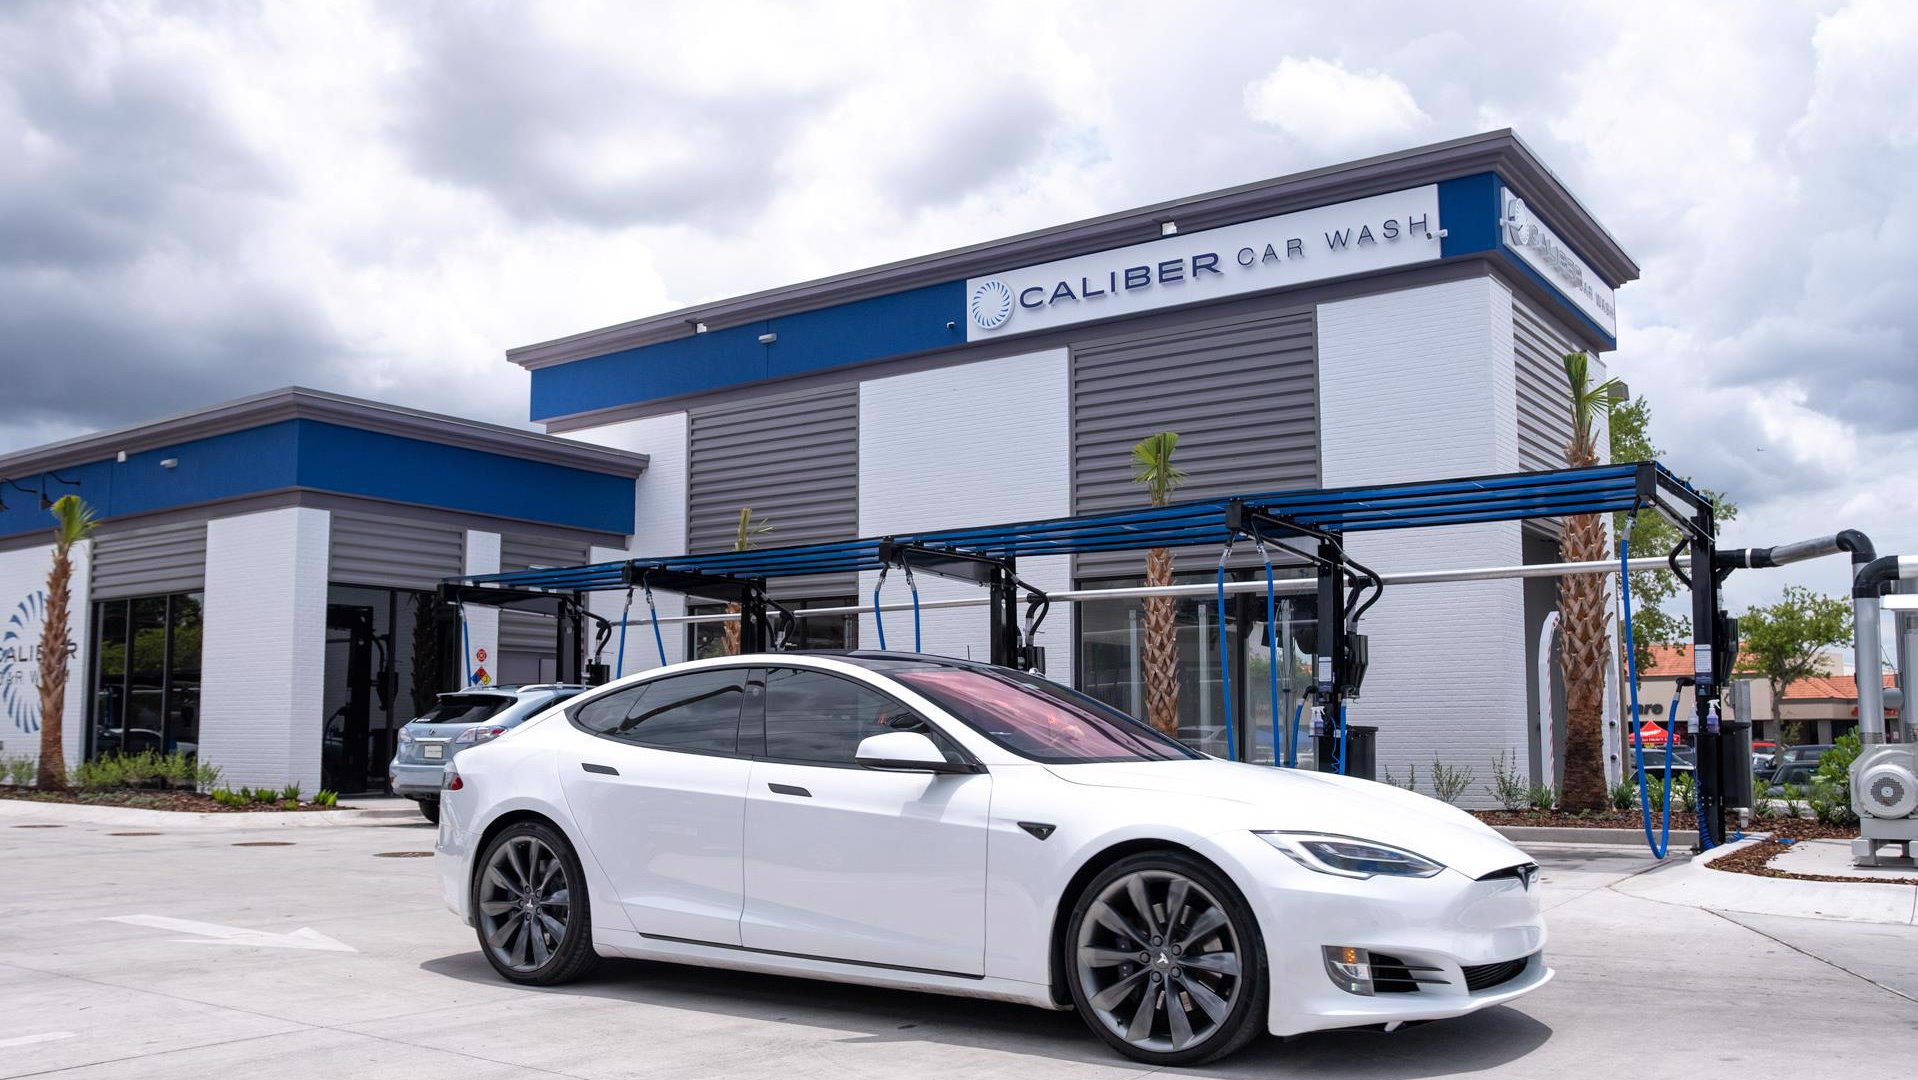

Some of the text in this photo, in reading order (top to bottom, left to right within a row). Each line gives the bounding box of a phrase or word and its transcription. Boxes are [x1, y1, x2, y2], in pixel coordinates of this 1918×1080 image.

[1019, 213, 1427, 309] CALIBER CAR WASH
